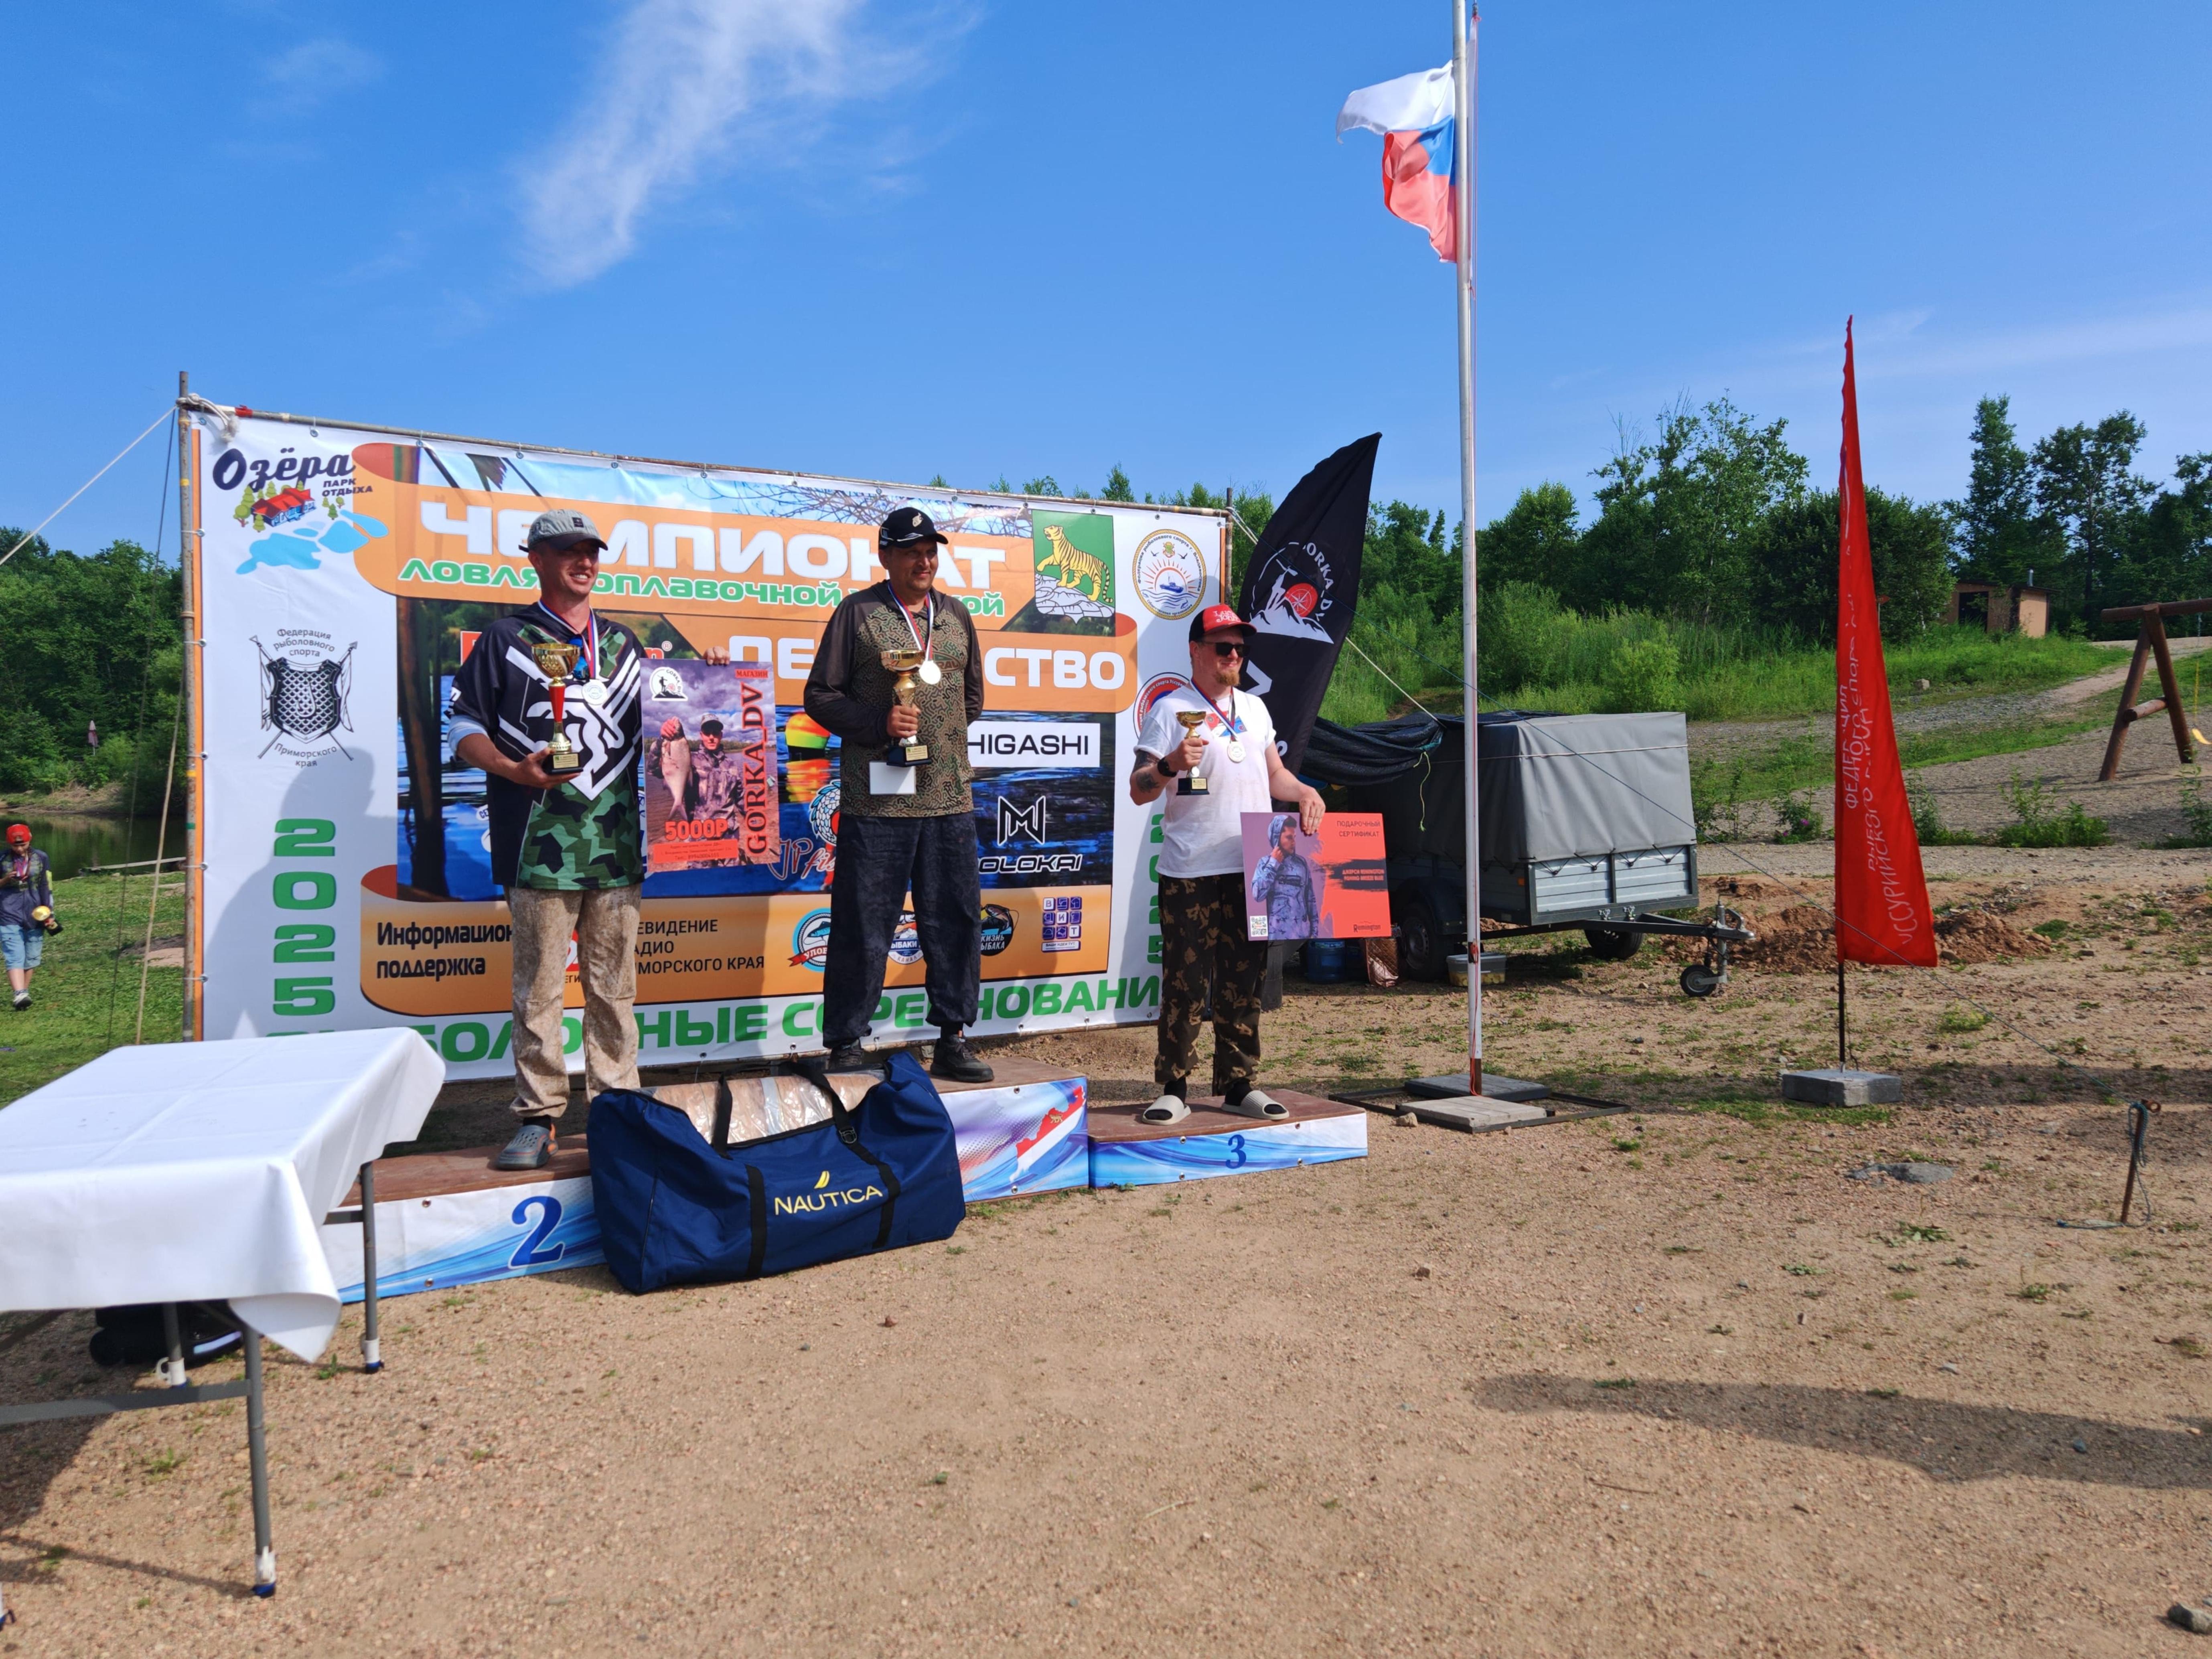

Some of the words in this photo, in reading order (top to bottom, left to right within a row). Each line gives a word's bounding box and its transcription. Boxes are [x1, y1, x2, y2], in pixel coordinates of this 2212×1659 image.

[212, 448, 356, 492] Озёра
[322, 485, 373, 497] ОТДЫХА
[323, 478, 357, 488] ПАРК
[590, 571, 843, 608] ОПЛАВОЧНОЙ
[277, 629, 331, 640] Федерация
[273, 638, 335, 652] рыболовного
[289, 648, 320, 657] спорта
[728, 635, 1125, 690] ПЕСТВО
[274, 743, 337, 759] Приморского
[296, 760, 317, 768] края
[742, 682, 768, 856] GORKA_DV
[979, 854, 1083, 874] OLOKAI
[377, 922, 512, 950] Информацион
[637, 919, 718, 936] ЕВИДЕНИЕ
[634, 941, 674, 957] АДИО
[890, 940, 917, 949] ЫБАКИ
[981, 941, 1005, 950] ЫБАКА
[377, 957, 486, 982] поддержка
[635, 958, 722, 975] МОРСКОГО
[727, 956, 764, 970] КРАЯ
[1225, 1134, 1246, 1170] 3
[774, 1185, 883, 1215] NAUTICA
[509, 1195, 565, 1269] 2
